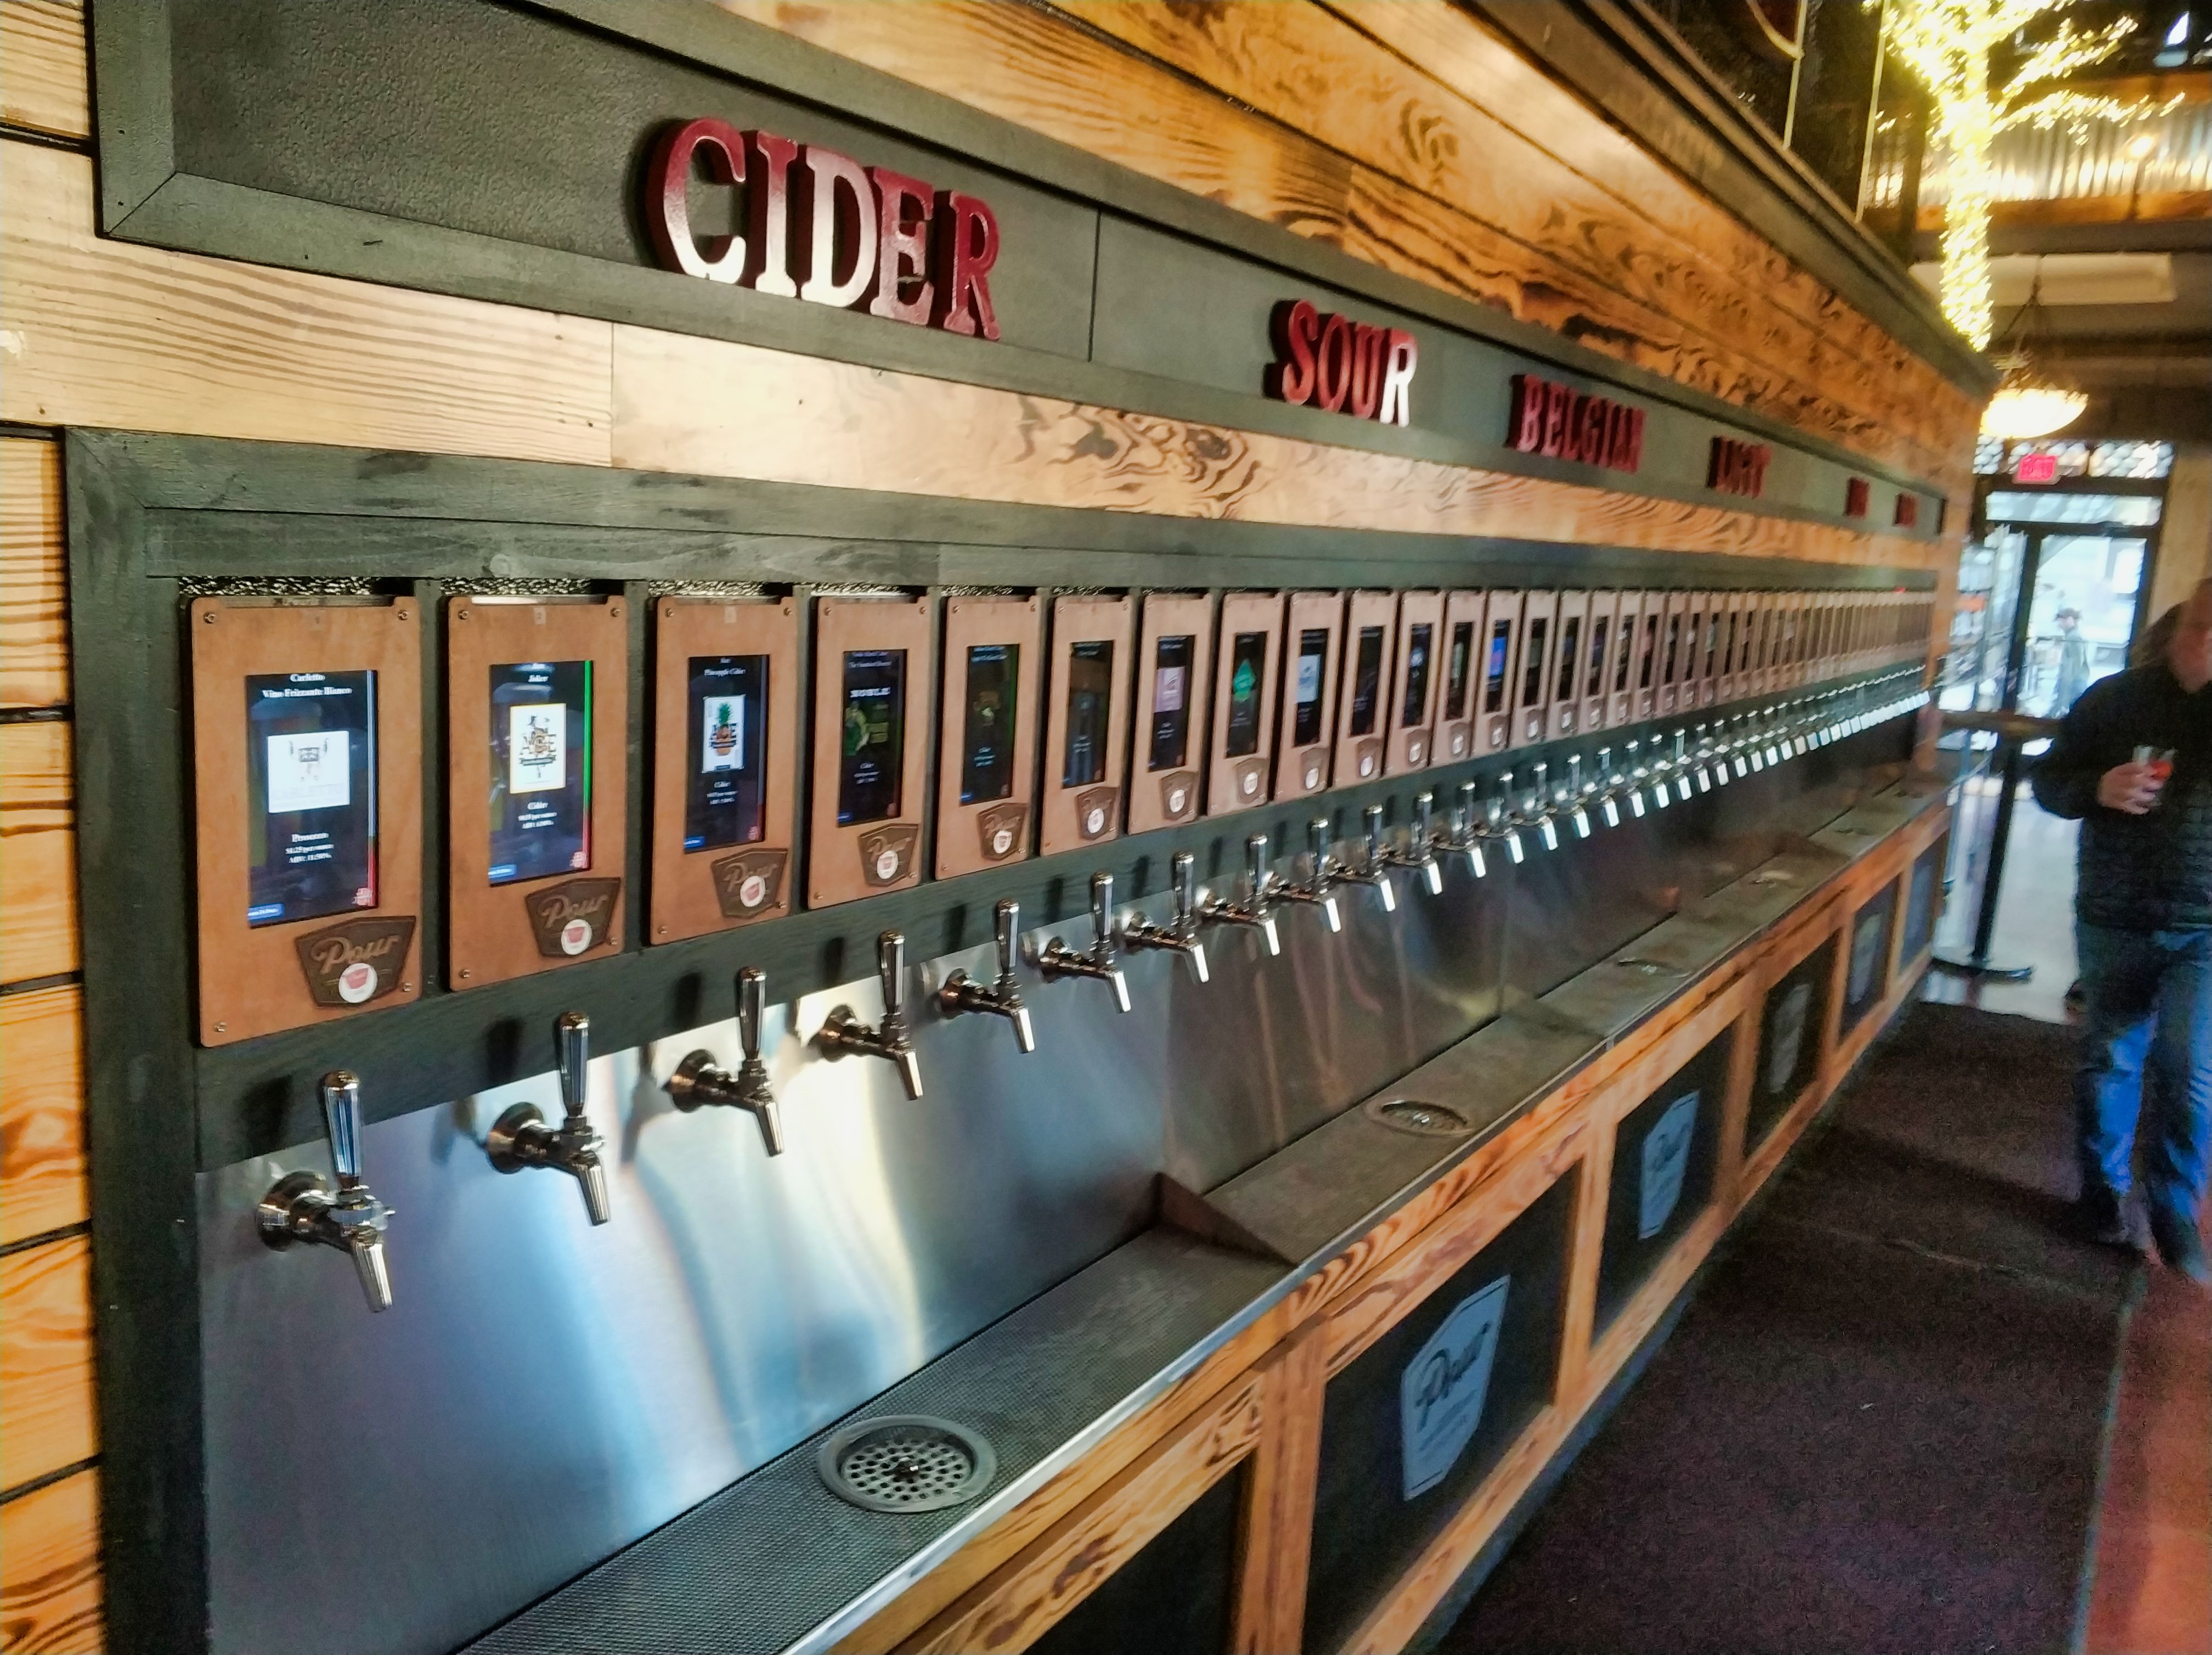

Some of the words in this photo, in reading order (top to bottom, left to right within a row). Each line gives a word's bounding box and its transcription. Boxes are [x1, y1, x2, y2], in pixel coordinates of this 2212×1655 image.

[656, 117, 1001, 341] CIDER
[1280, 299, 1419, 428] SOUR
[310, 934, 400, 975] Pour
